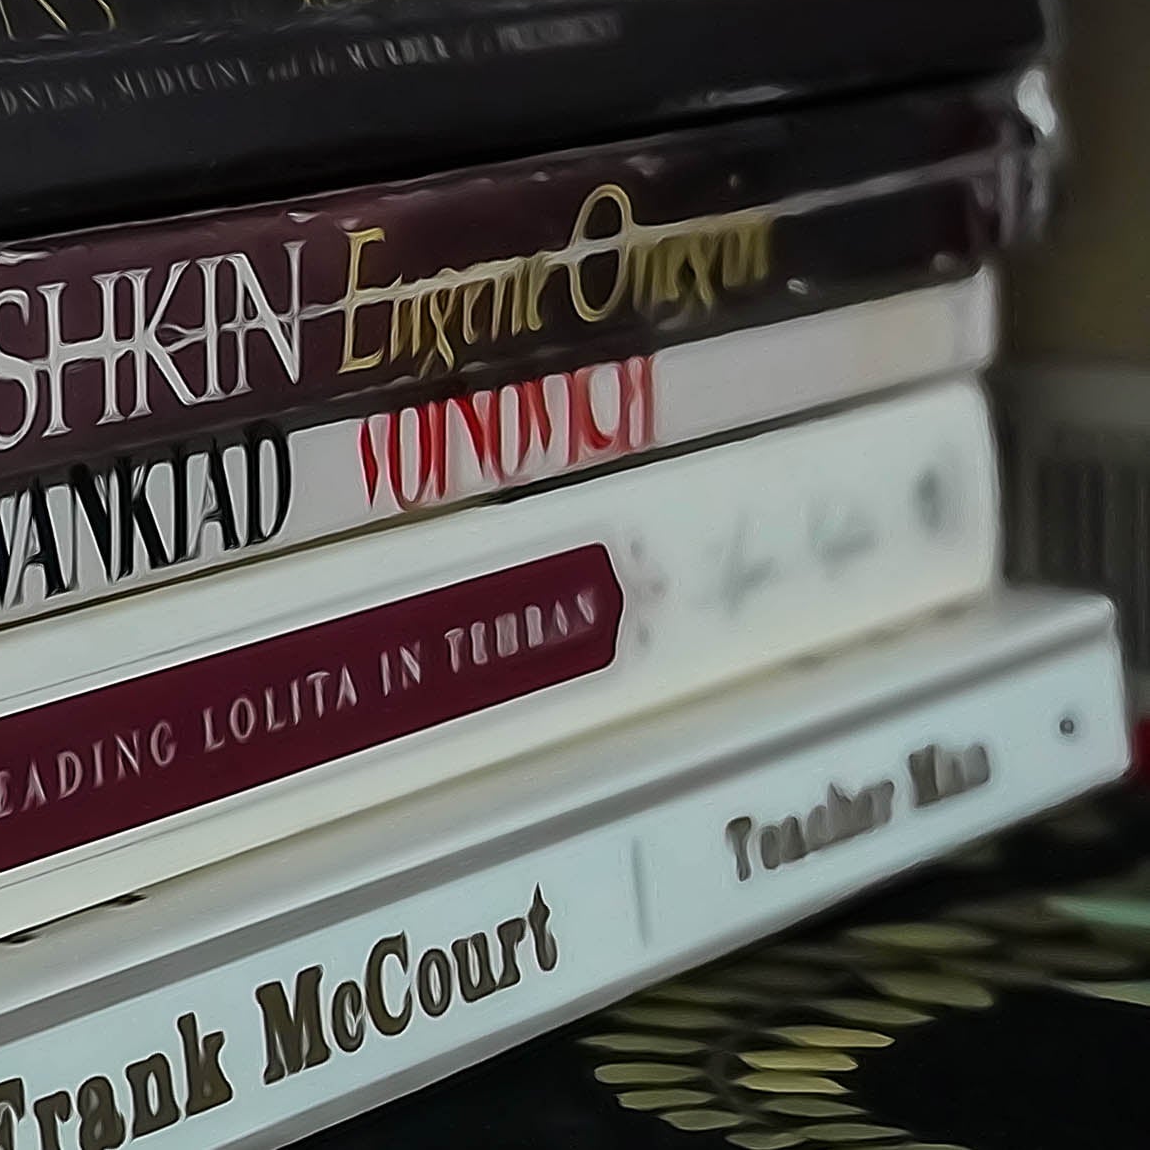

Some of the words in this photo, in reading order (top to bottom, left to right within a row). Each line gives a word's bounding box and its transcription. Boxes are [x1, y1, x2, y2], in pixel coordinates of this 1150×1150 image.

[202, 664, 358, 751] LOLITA
[379, 640, 422, 698] IN
[254, 881, 559, 1087] McCourt
